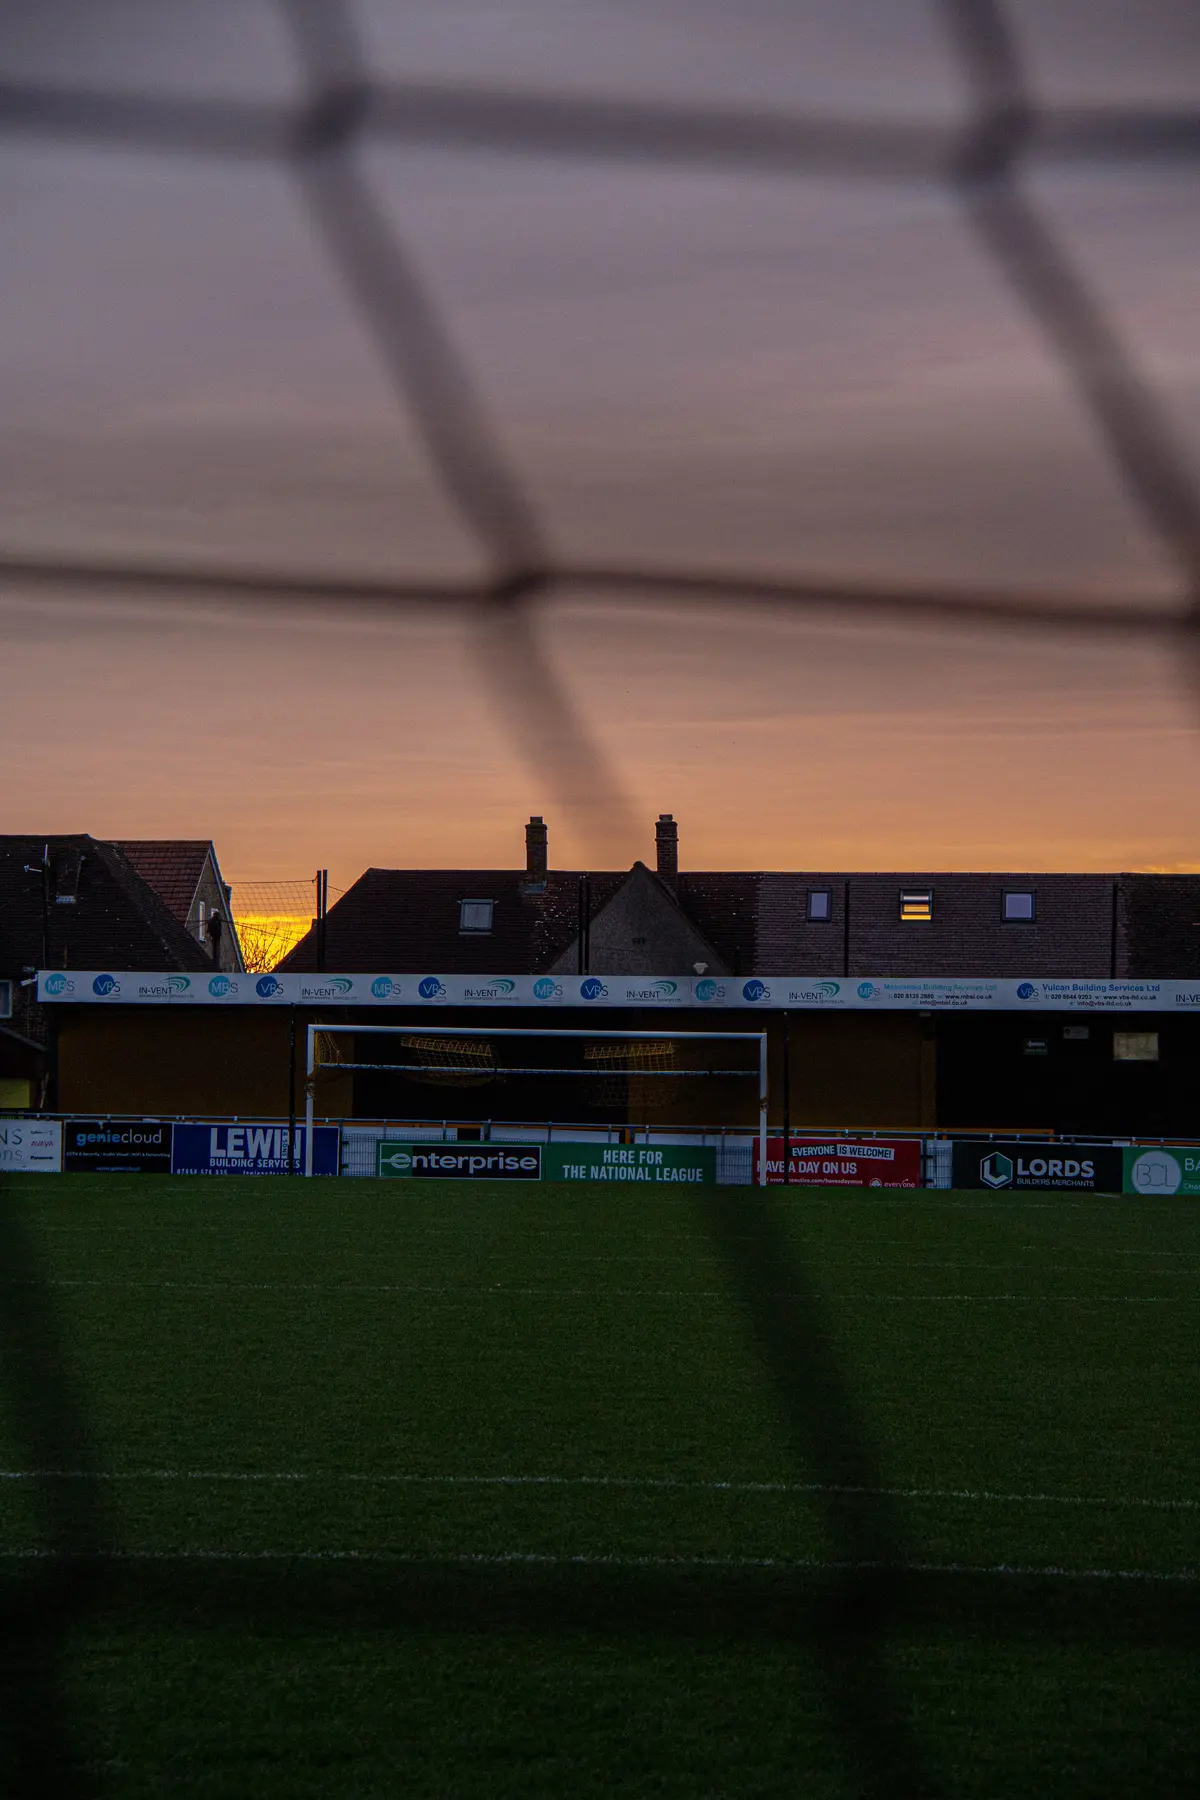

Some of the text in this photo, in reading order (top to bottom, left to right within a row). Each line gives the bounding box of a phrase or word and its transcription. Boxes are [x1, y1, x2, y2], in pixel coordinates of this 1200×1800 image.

[48, 980, 76, 992] MBS
[97, 981, 121, 993] VBS
[211, 982, 238, 994] MBS
[260, 983, 284, 994] VBS
[374, 984, 401, 995] MBS
[423, 984, 446, 996] VBS
[536, 984, 564, 996] MBS
[585, 985, 609, 996] VBS
[698, 986, 726, 998] MBS
[748, 986, 771, 998] VBS
[860, 988, 881, 996] MBS
[1072, 984, 1106, 992] Building
[1020, 988, 1039, 997] VBS
[76, 1128, 162, 1147] geniecloud
[603, 1150, 663, 1164] HERE FOR
[792, 1146, 892, 1158] EVERYONE IS WELCOME!
[210, 1158, 254, 1168] BUILDING
[390, 1152, 538, 1174] enterprise
[788, 1161, 796, 1172] A
[798, 1162, 820, 1174] DAY
[822, 1162, 838, 1174] ON
[841, 1163, 858, 1174] US
[1016, 1158, 1095, 1178] LORDS
[562, 1165, 704, 1182] THE NATIONAL LEAGUE
[1016, 1178, 1050, 1186] BUILDERS
